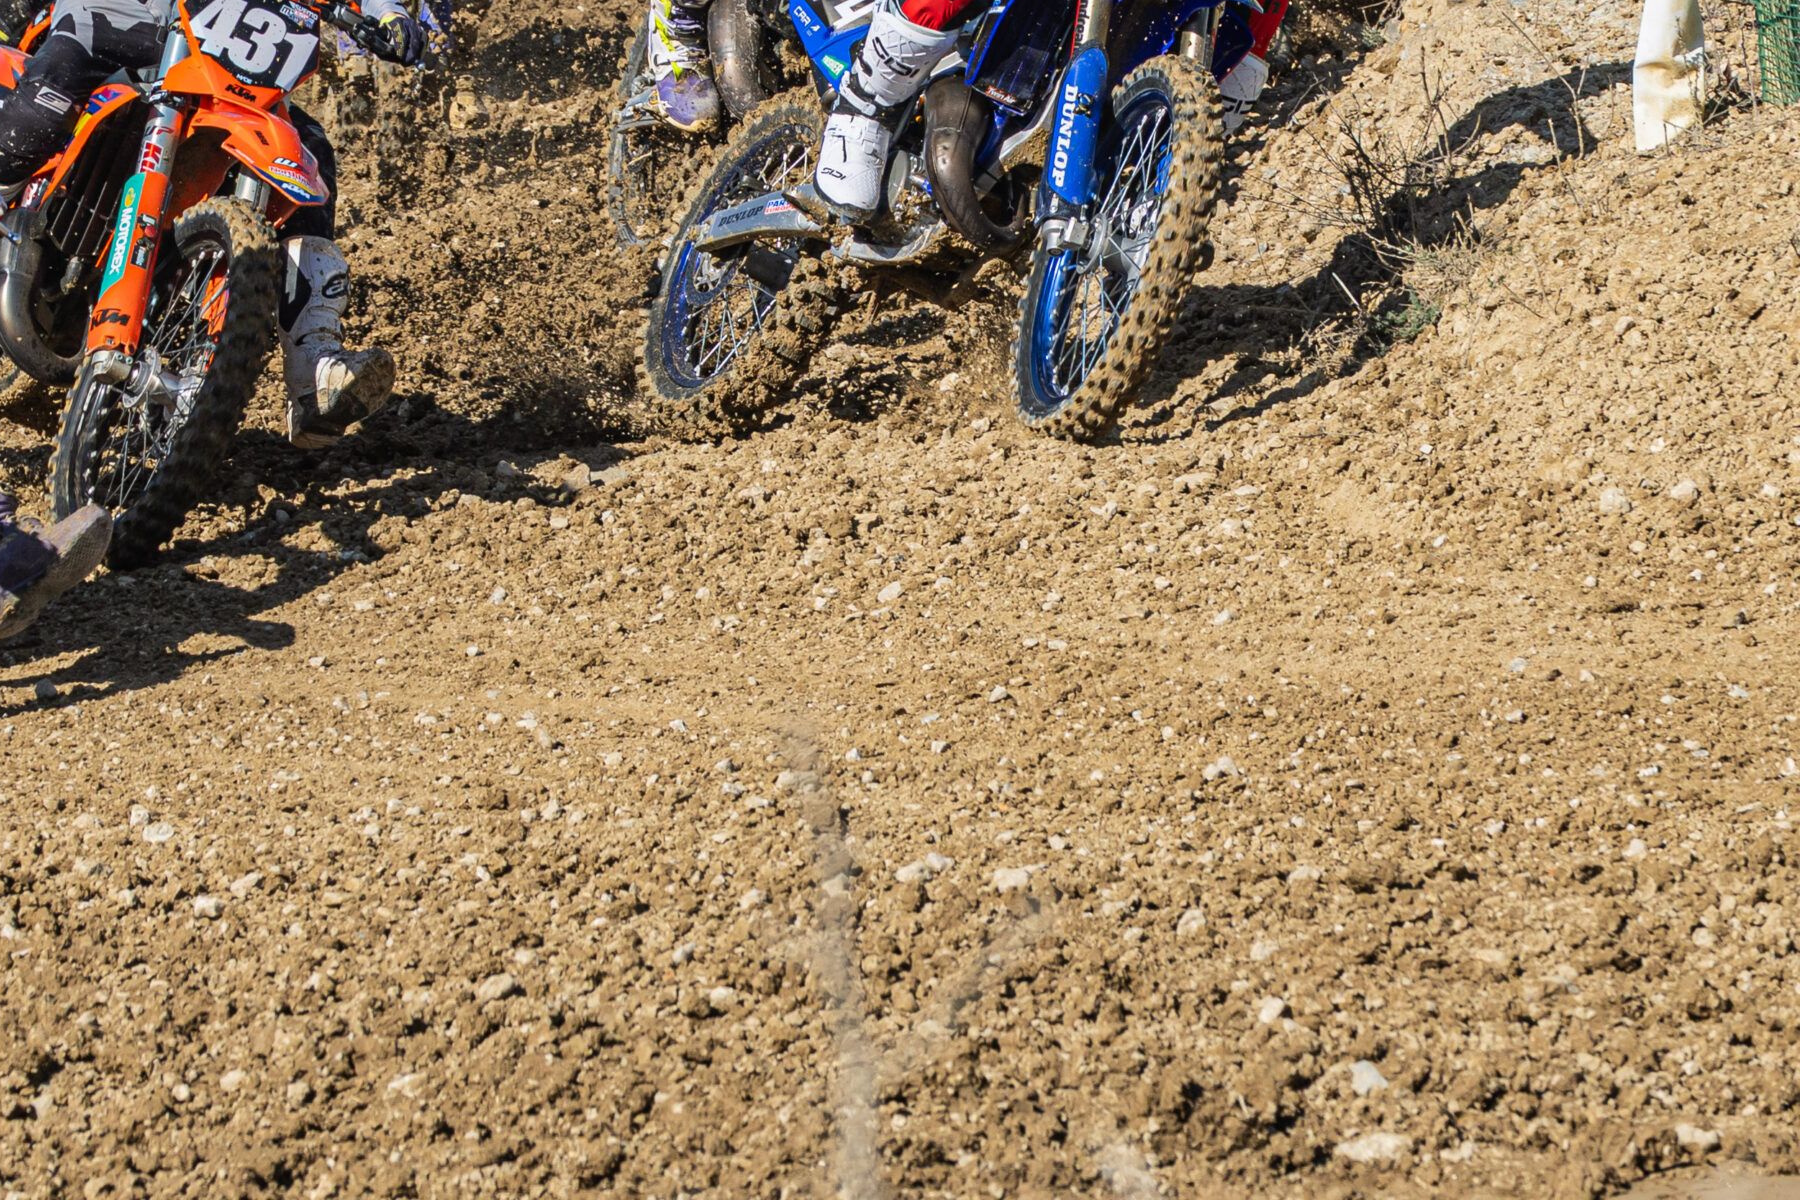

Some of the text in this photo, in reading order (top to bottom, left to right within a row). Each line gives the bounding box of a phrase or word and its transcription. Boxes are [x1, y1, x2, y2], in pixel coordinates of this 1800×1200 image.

[225, 83, 257, 103] KTM
[1053, 84, 1078, 188] DUNLOP
[717, 205, 764, 228] DUNLOP
[109, 205, 135, 276] MOTOREX
[90, 306, 129, 331] KTM
